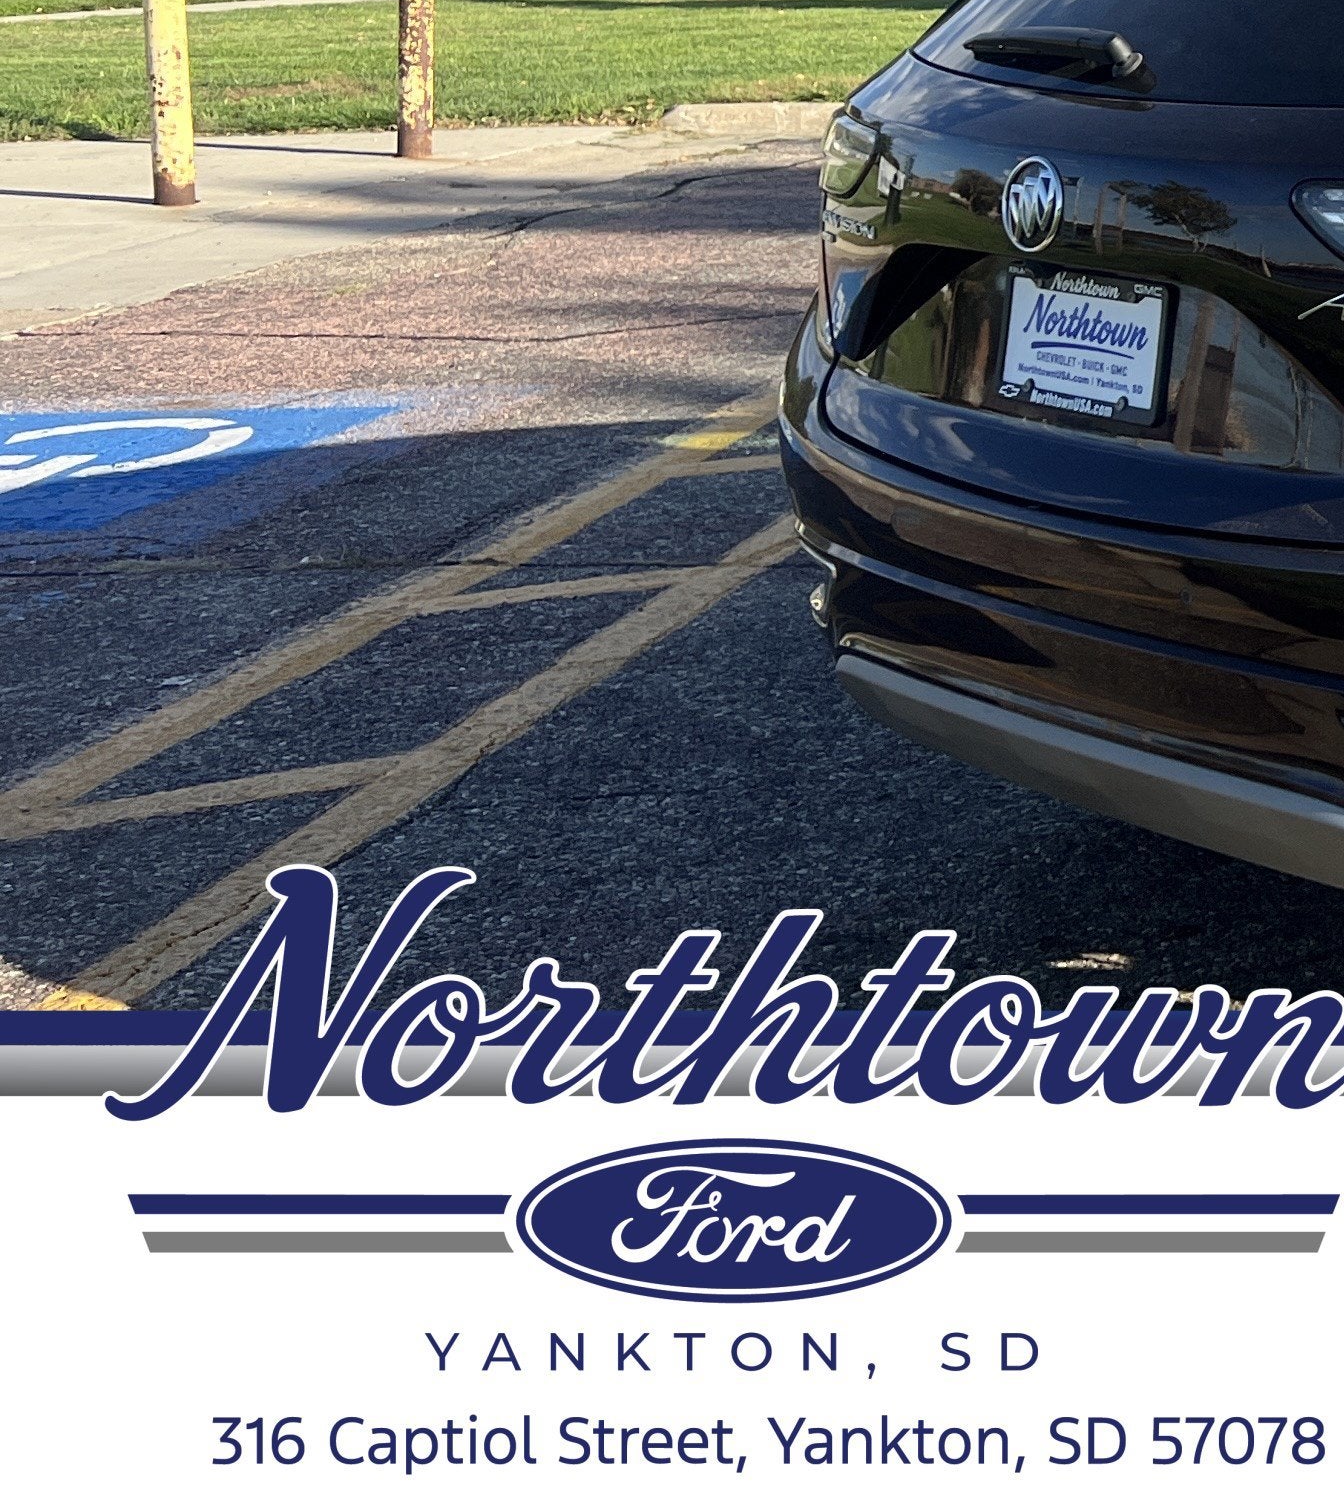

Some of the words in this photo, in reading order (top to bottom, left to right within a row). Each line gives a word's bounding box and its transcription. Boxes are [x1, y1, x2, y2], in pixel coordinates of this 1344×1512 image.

[1050, 271, 1121, 299] Northtown
[1133, 284, 1163, 297] GMC
[1023, 293, 1148, 351] Northtown
[1029, 388, 1113, 418] NorthtownUSA.com
